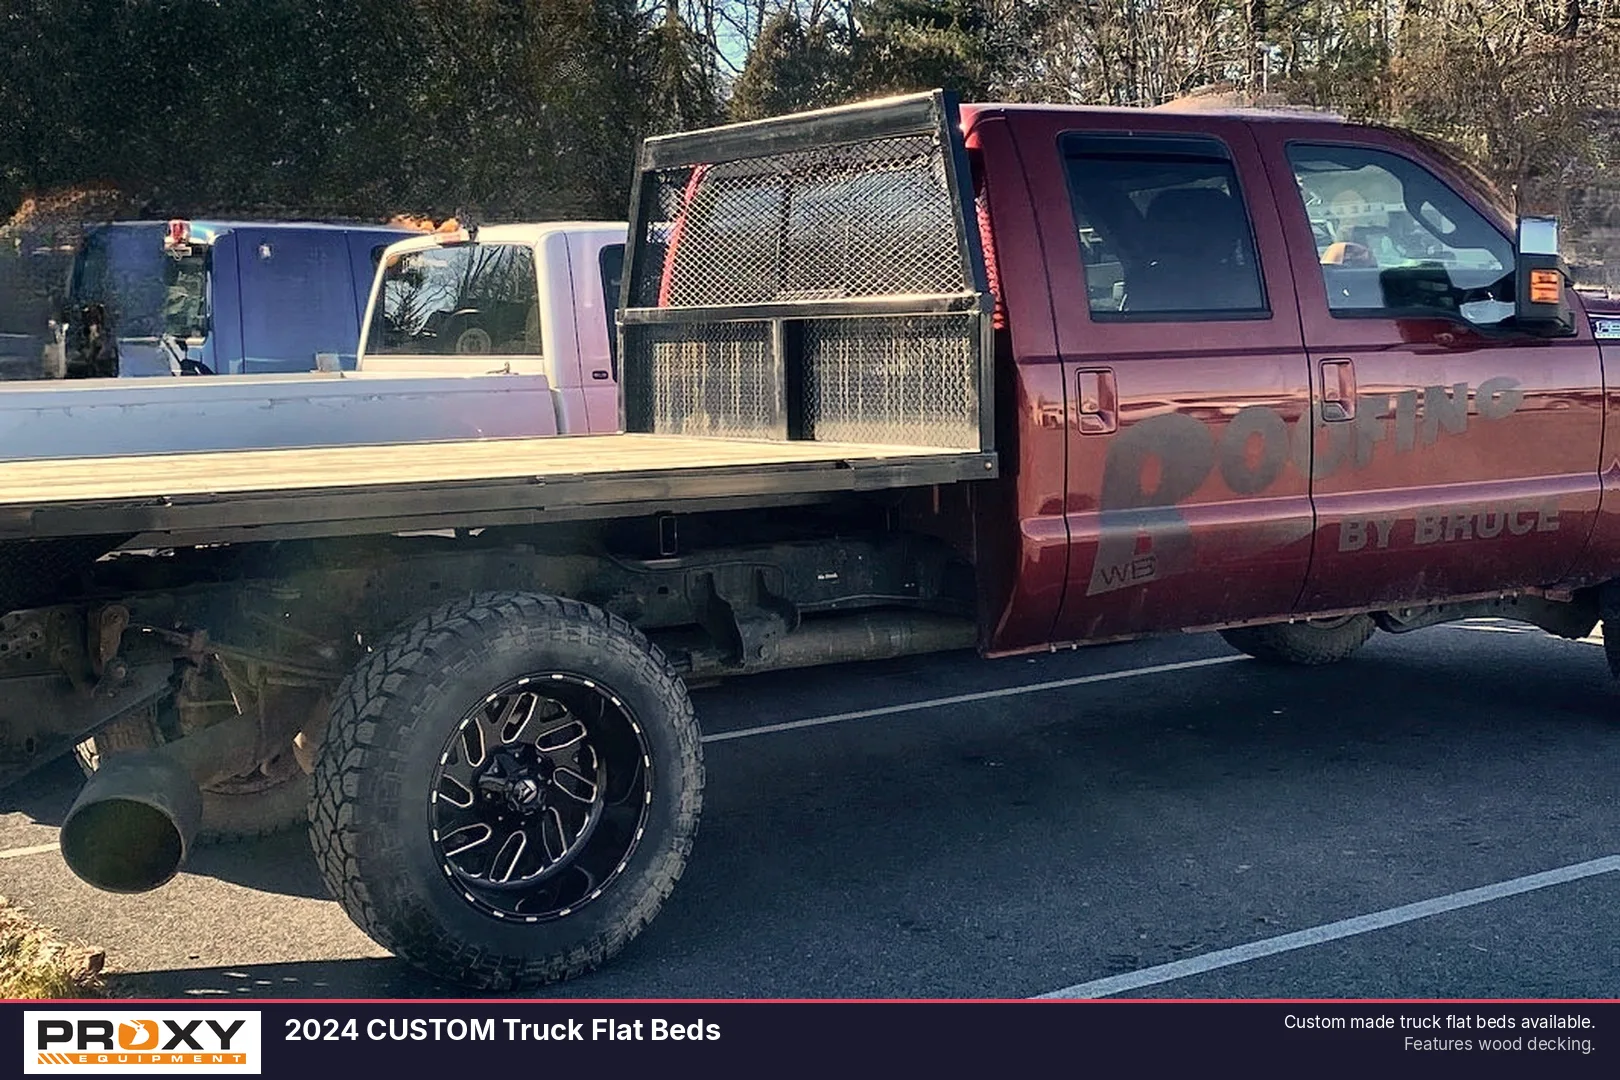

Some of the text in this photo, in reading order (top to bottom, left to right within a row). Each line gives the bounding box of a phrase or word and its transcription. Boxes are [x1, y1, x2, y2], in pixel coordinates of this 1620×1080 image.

[1086, 376, 1524, 596] ROOFING
[1338, 500, 1560, 552] BY BRUCE
